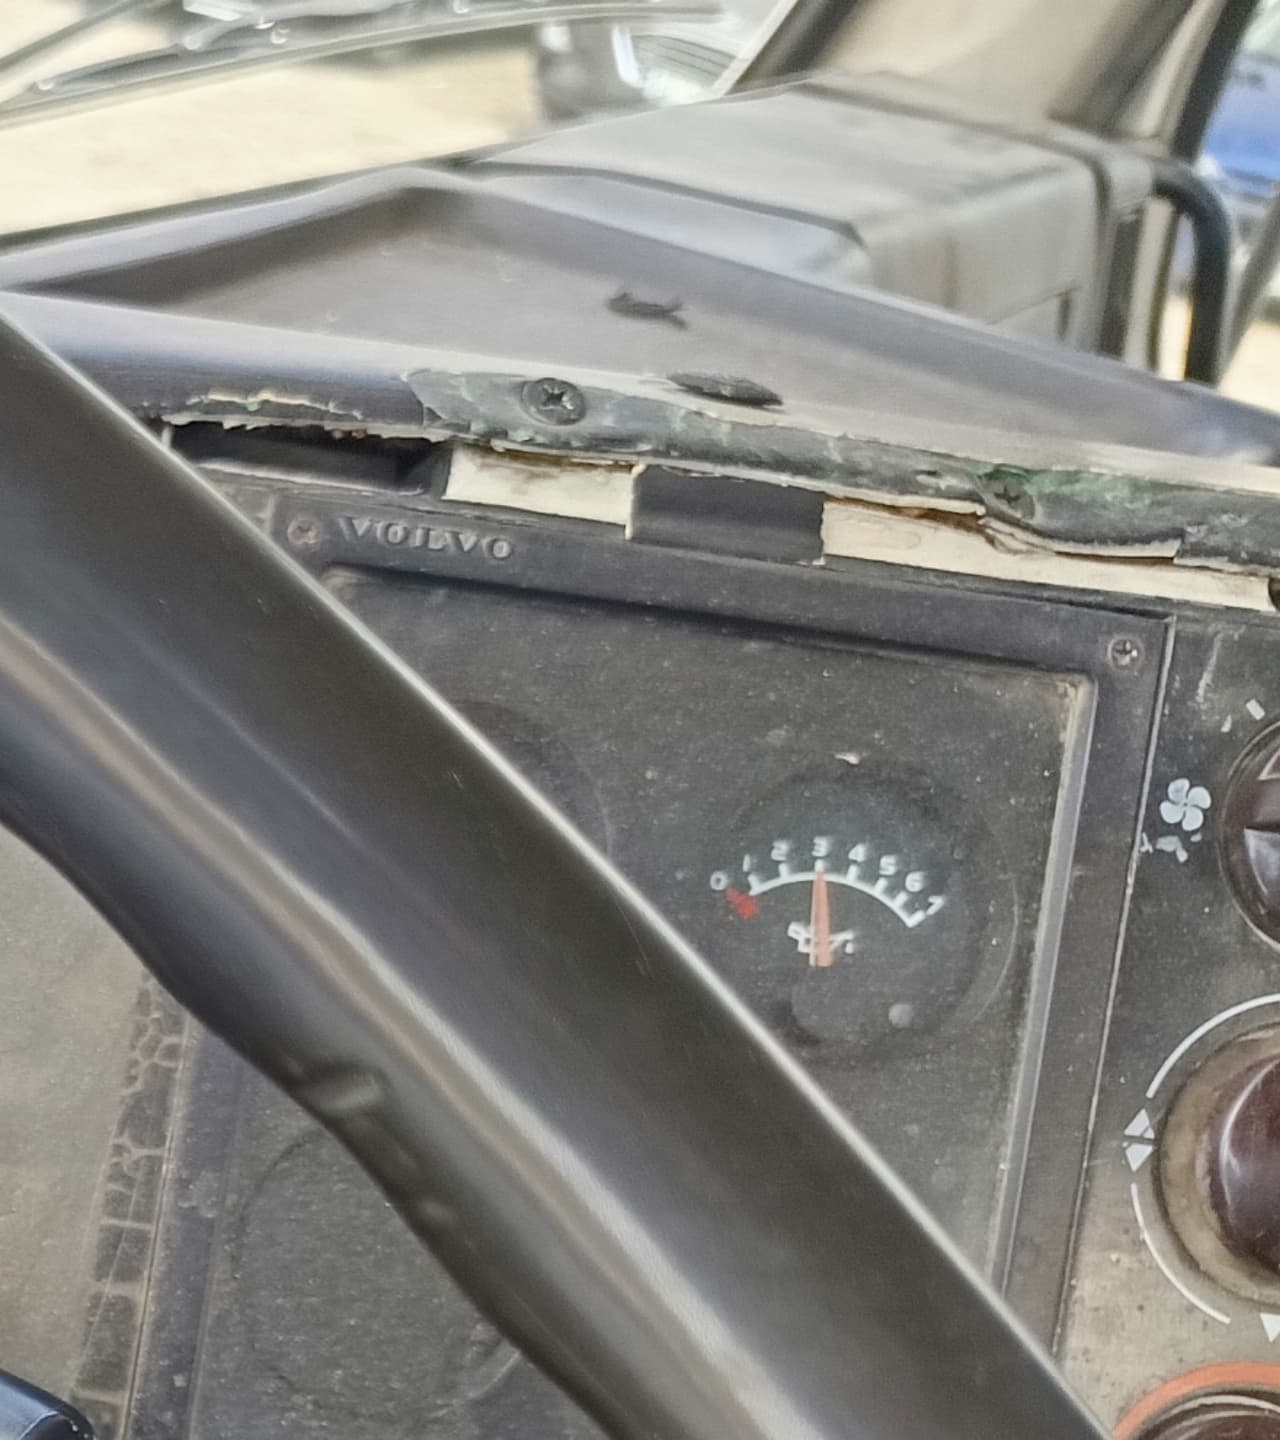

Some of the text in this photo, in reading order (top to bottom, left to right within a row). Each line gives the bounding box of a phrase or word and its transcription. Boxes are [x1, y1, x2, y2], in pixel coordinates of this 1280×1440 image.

[338, 516, 514, 562] VOLVO
[710, 871, 728, 891] 0
[771, 841, 791, 862] 2
[811, 836, 832, 857] 3
[848, 844, 868, 862] 4
[880, 855, 896, 875] 5
[905, 872, 925, 893] 6
